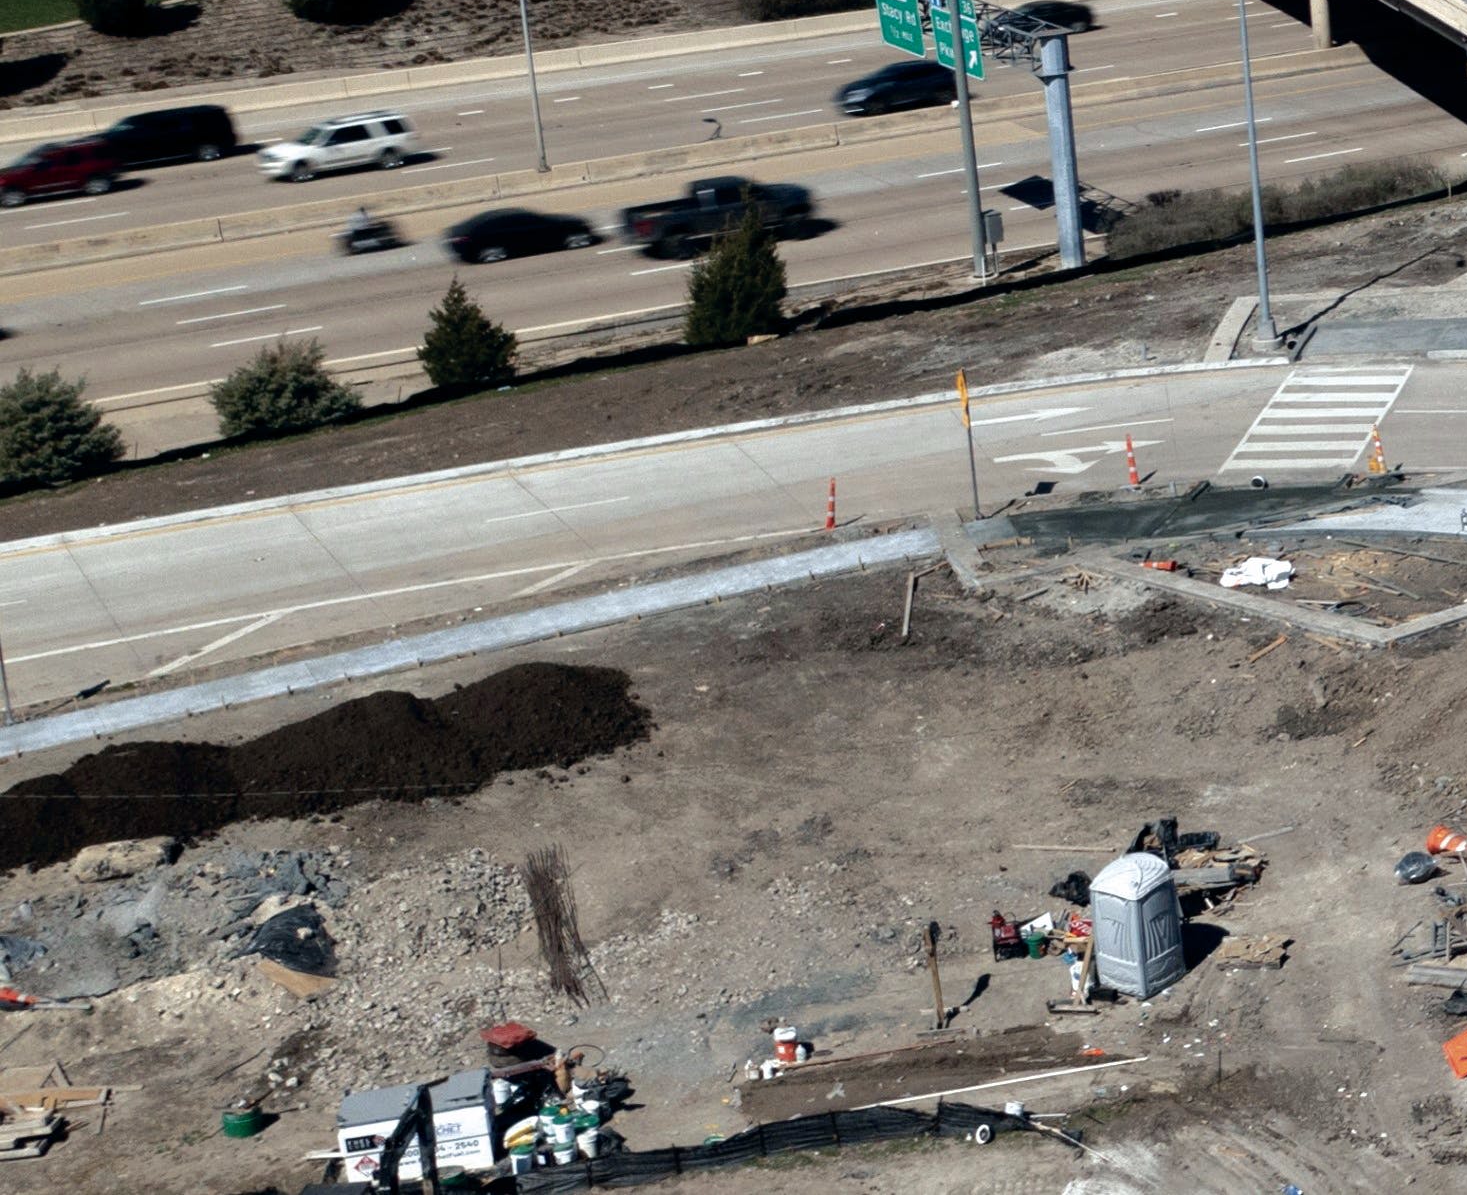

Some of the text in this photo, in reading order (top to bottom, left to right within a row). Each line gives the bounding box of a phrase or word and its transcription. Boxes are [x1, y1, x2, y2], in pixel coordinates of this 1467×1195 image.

[882, 2, 916, 26] Stacy Rd
[961, 0, 972, 15] 36
